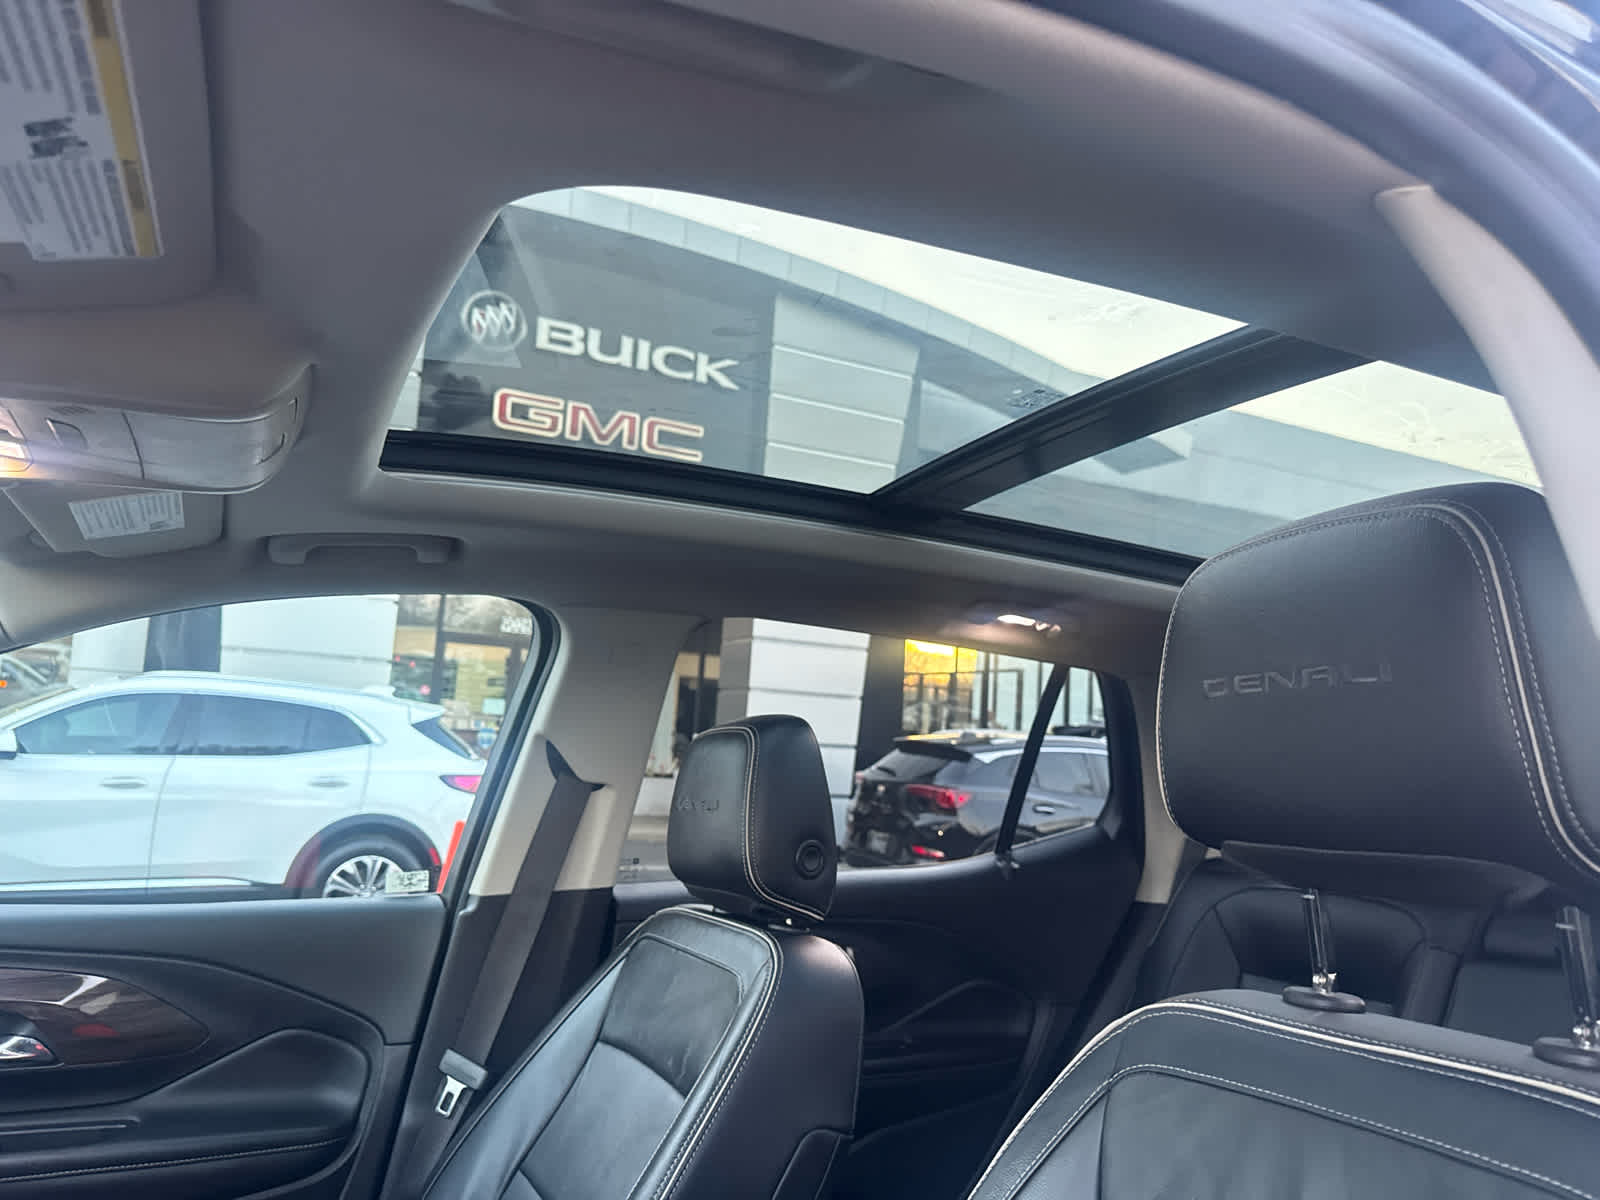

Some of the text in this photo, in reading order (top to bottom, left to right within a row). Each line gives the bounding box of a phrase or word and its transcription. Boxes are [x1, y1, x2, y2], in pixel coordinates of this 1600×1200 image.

[535, 316, 740, 391] BUICK
[492, 388, 705, 462] GMC
[1202, 664, 1393, 698] DENALI
